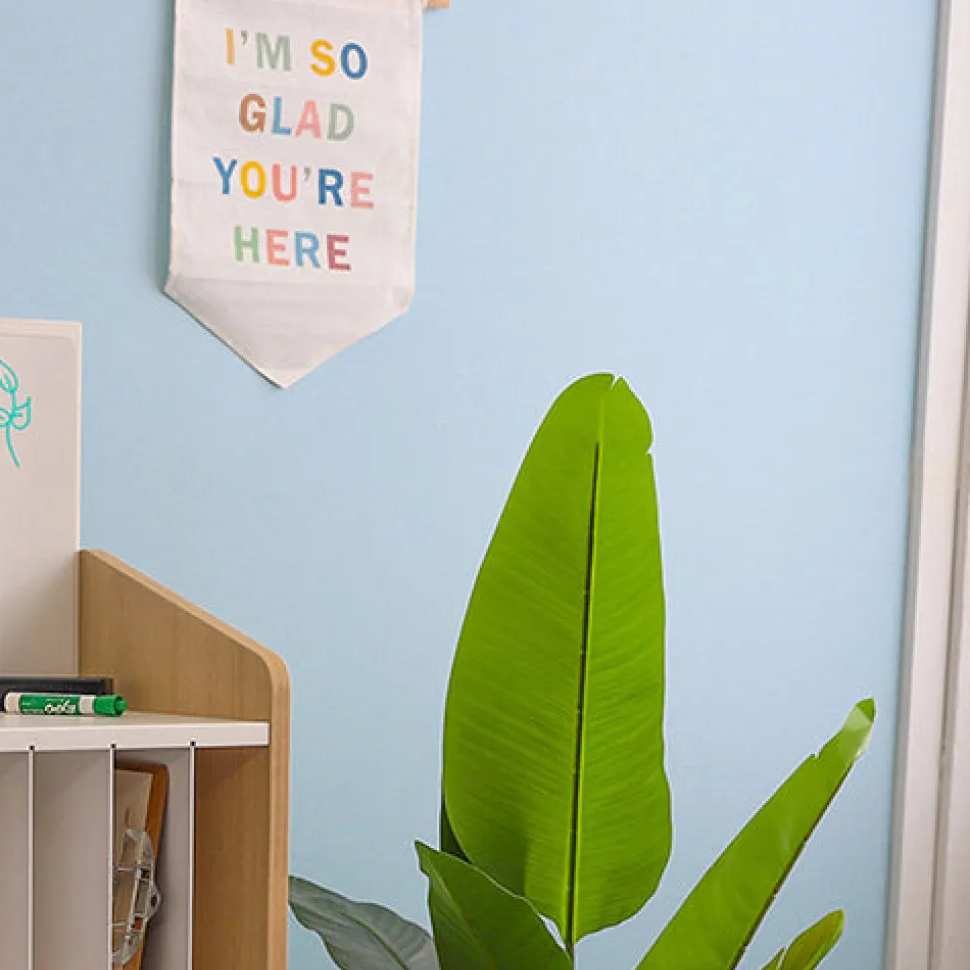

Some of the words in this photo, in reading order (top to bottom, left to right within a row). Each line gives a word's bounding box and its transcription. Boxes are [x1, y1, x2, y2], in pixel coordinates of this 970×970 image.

[225, 28, 292, 71] I'M
[310, 39, 368, 80] SO
[238, 93, 355, 142] GLAD
[213, 156, 375, 210] YOU'RE
[234, 225, 352, 272] HERE
